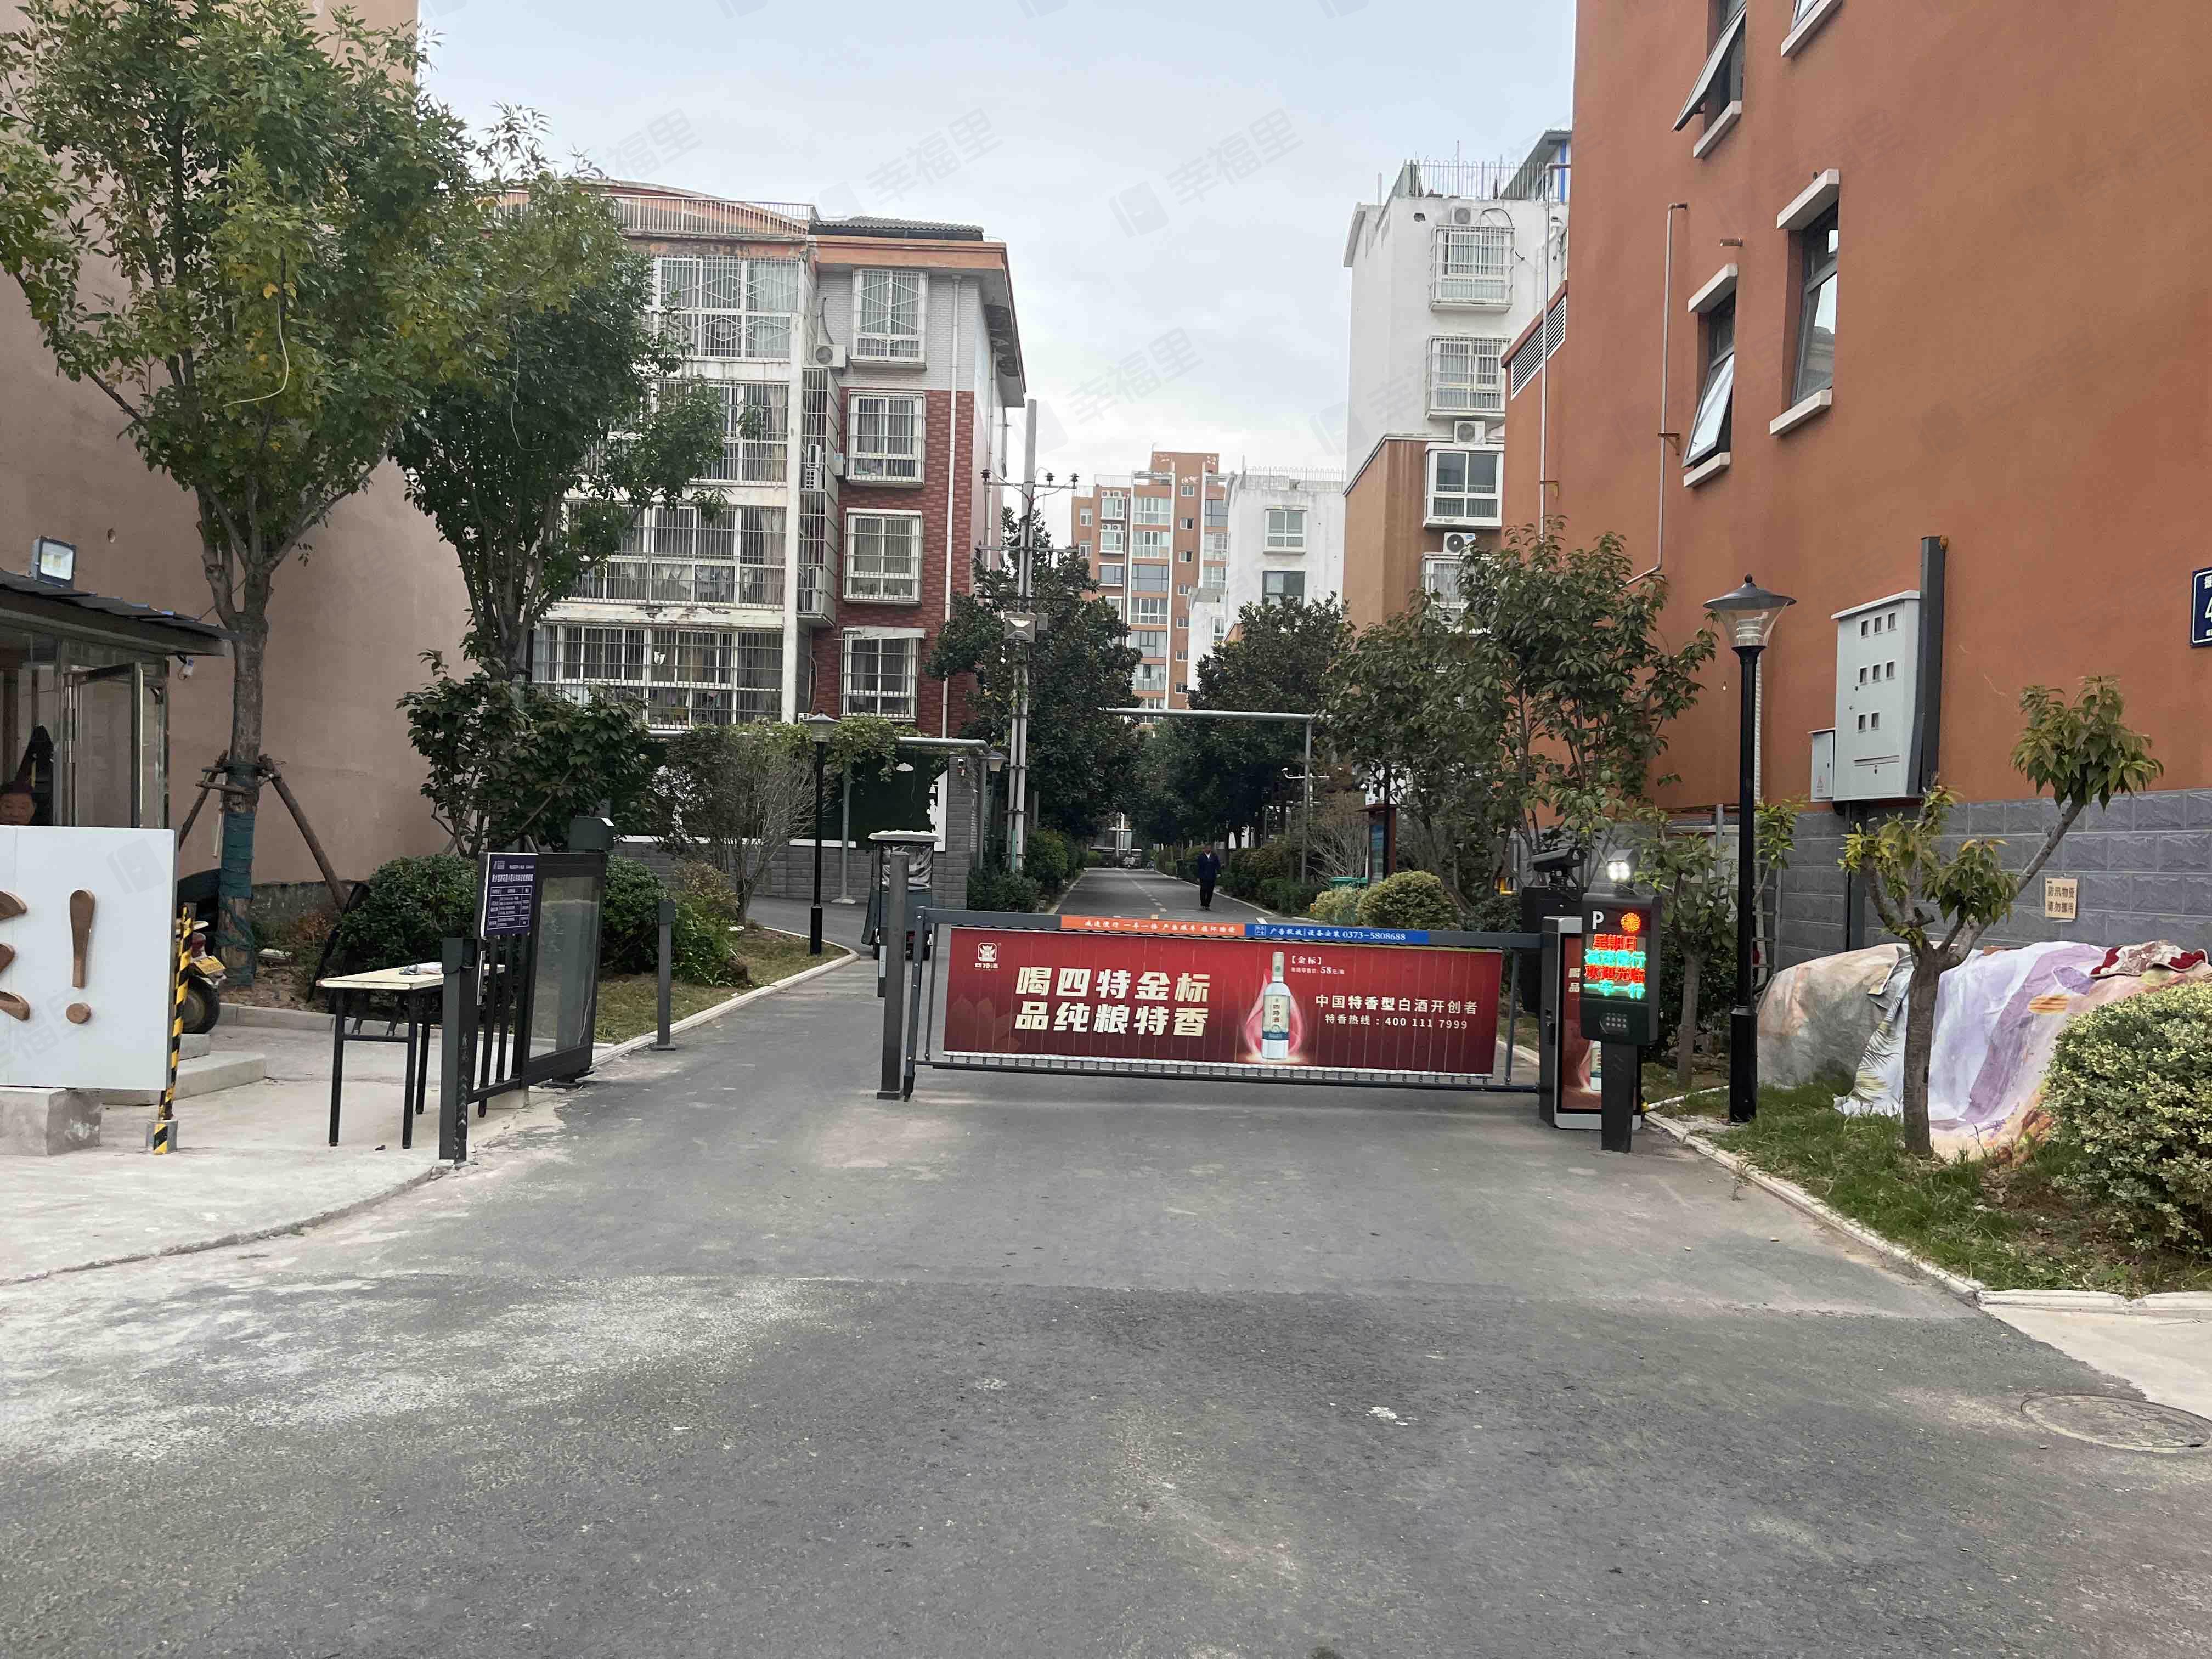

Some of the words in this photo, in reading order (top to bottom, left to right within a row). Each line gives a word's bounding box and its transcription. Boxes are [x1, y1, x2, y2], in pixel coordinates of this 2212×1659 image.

[1592, 911, 1604, 929] P
[1342, 930, 1406, 940] 0373-5808688
[1592, 934, 1637, 952] 星期日
[1584, 964, 1645, 984] 欢迎光临
[1015, 967, 1210, 1003] 喝四特金标
[1316, 994, 1478, 1014] 中国特香型白酒开创者
[1014, 1001, 1209, 1037] 品纯粮特香
[1385, 1017, 1407, 1026] 400
[1412, 1018, 1432, 1028] 111
[1439, 1019, 1468, 1029] 7999
